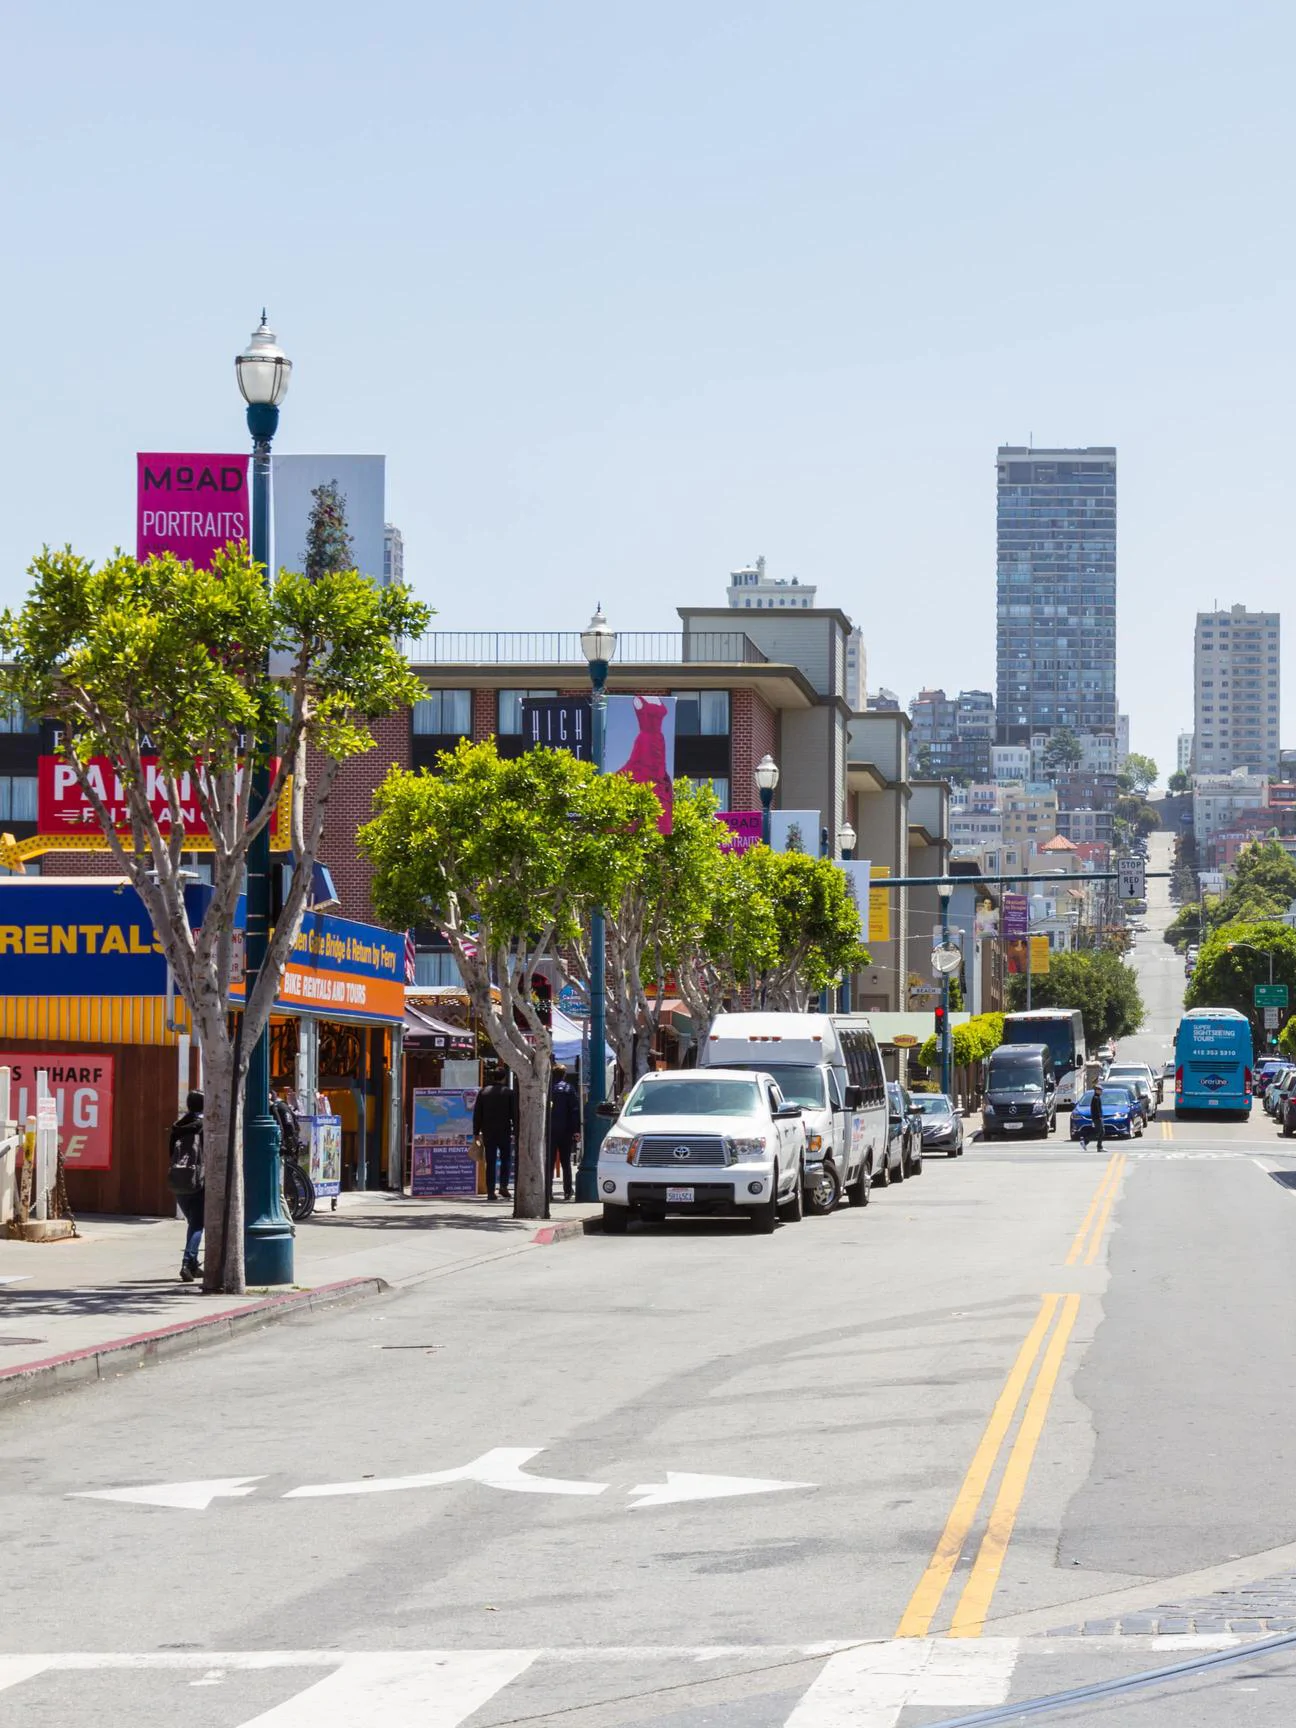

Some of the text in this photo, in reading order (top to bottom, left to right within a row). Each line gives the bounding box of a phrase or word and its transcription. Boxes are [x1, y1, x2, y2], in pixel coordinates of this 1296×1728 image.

[143, 510, 244, 538] PORTRAITS
[532, 709, 583, 741] HIGH
[1121, 861, 1141, 869] STOP
[1123, 876, 1140, 884] RED
[325, 932, 346, 963] Bridge
[346, 937, 351, 960] &
[352, 938, 372, 963] Return
[373, 942, 380, 970] by
[381, 944, 397, 974] Ferry
[284, 971, 367, 1005] BIKE RENTALS AND TOURS
[1193, 1029, 1235, 1037] SIGHTSEEING
